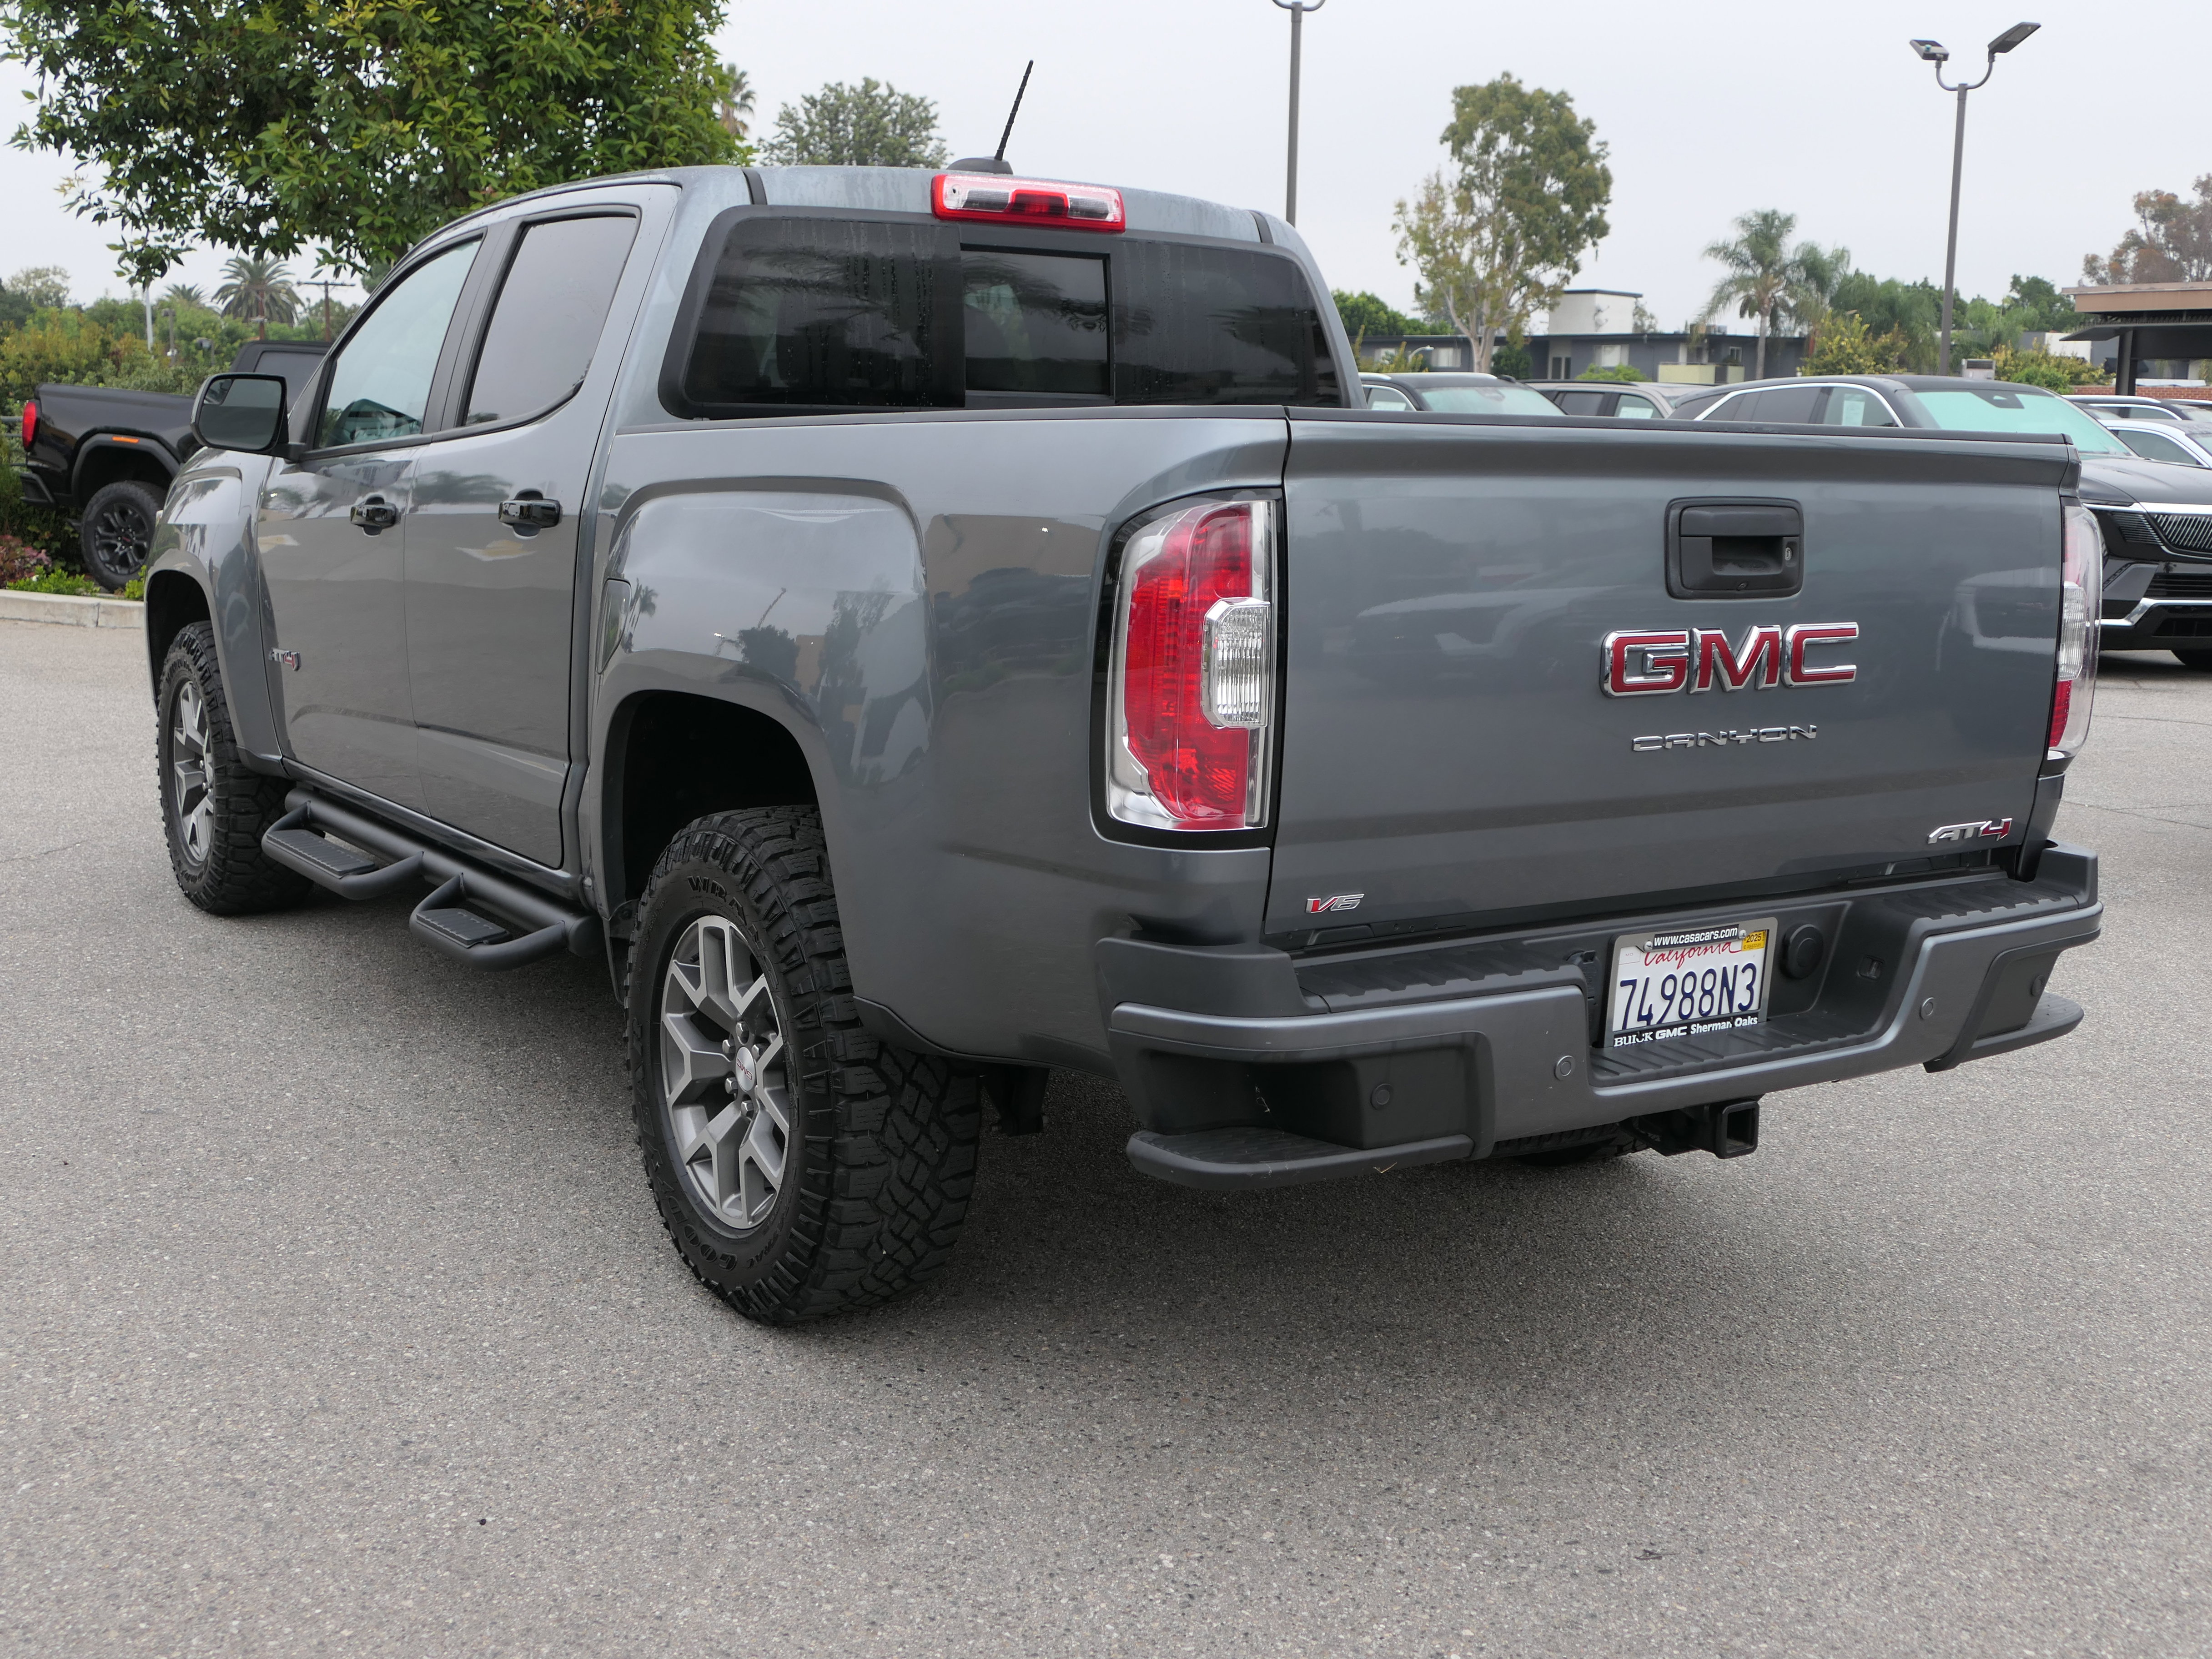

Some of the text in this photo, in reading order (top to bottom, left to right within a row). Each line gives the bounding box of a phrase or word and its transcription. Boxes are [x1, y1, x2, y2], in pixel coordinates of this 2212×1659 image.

[269, 647, 301, 671] AT4
[1600, 622, 1860, 698] GMC
[1632, 725, 1817, 752] CANYON
[1927, 818, 2012, 844] AT4
[1305, 893, 1364, 914] V6
[1654, 926, 1738, 946] www.casacars.com
[1746, 933, 1762, 943] 2025
[1644, 941, 1742, 970] California
[1619, 962, 1757, 1030] 74988N3
[1655, 1026, 1689, 1041] GMC
[1690, 1020, 1733, 1035] Sherman
[1734, 1016, 1758, 1027] Oaks
[736, 1058, 753, 1081] GMC
